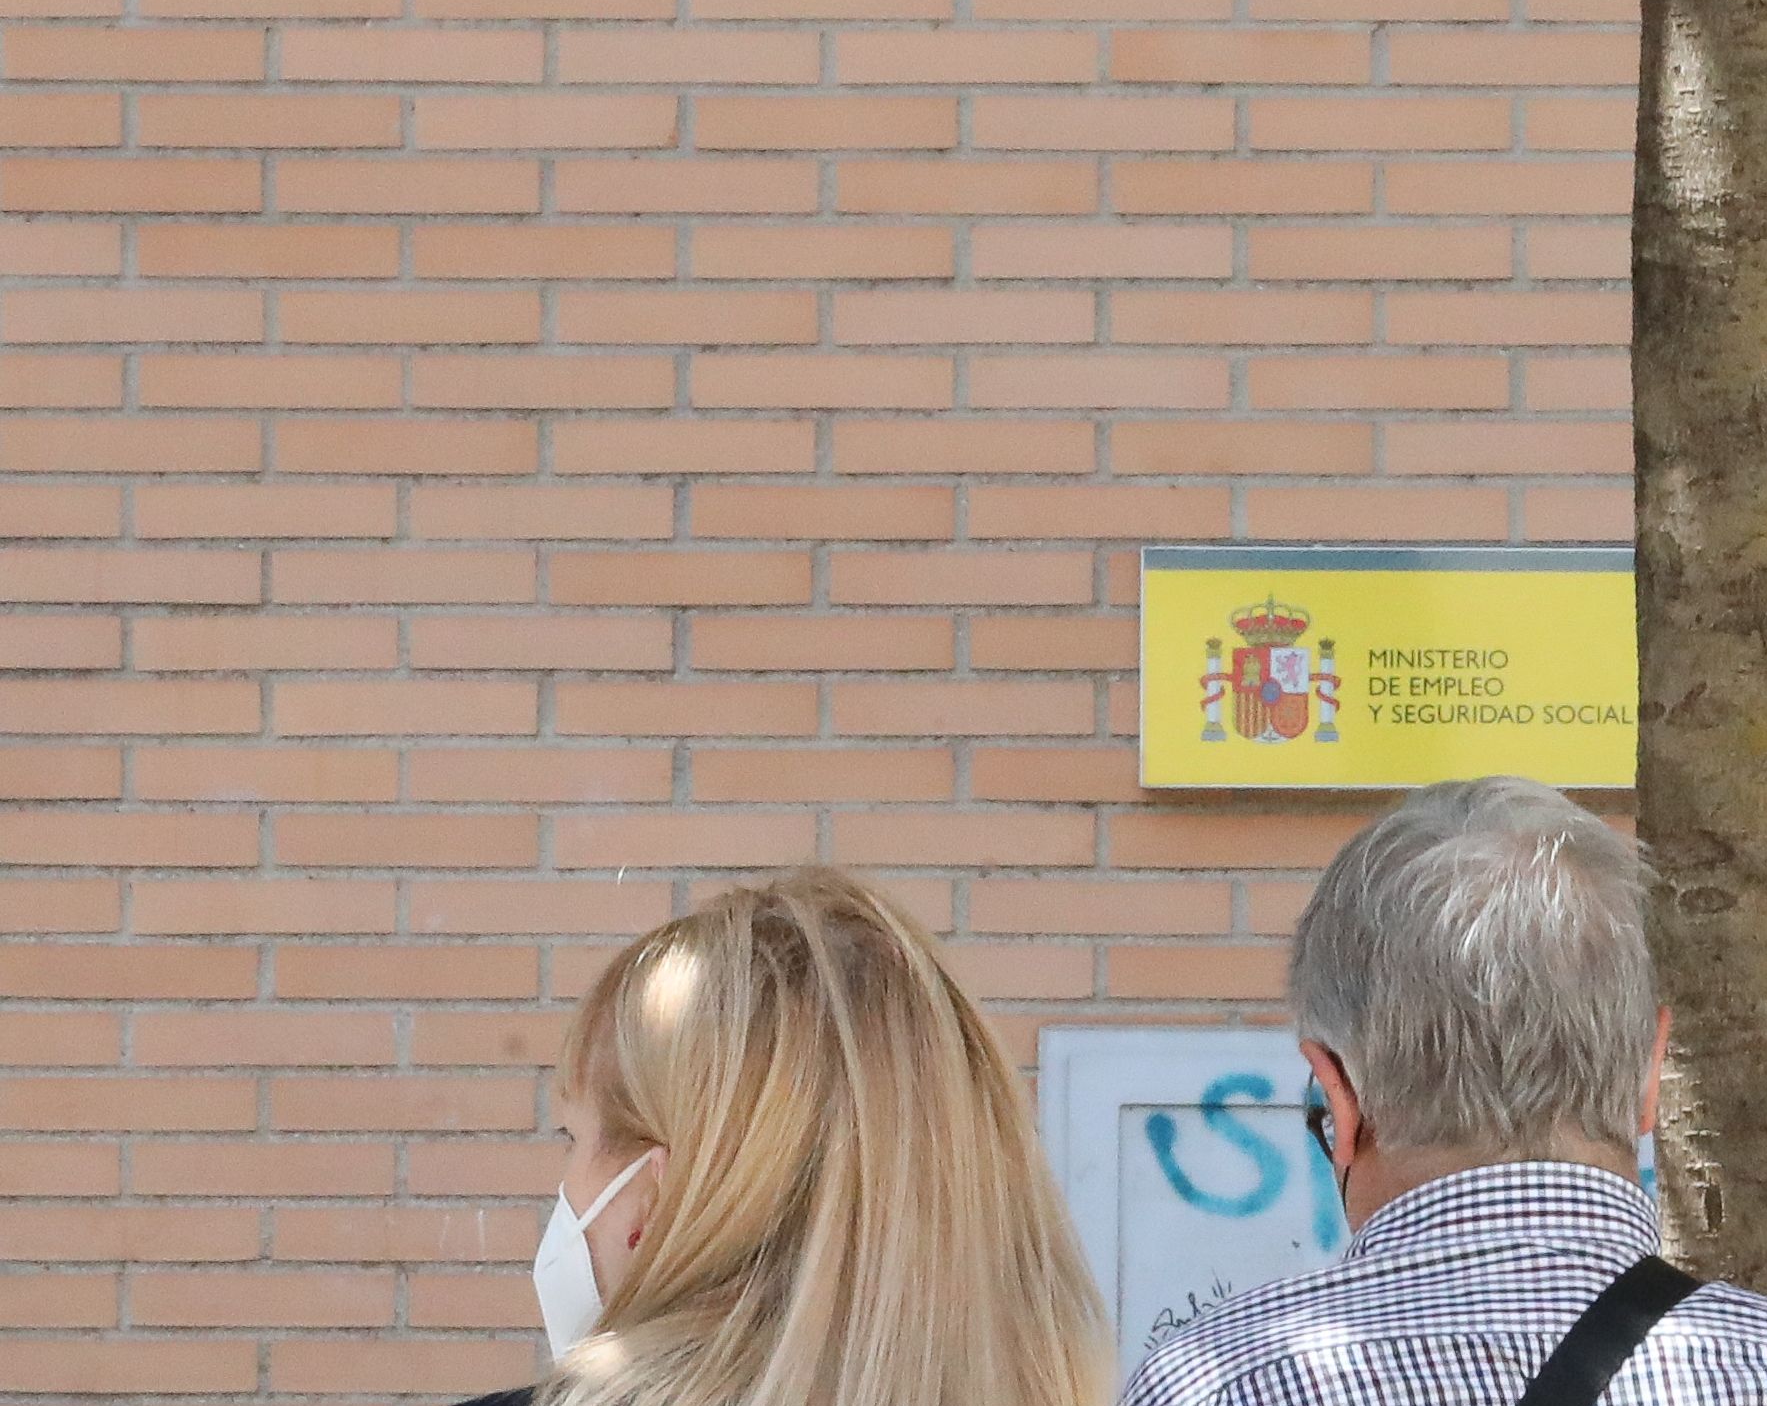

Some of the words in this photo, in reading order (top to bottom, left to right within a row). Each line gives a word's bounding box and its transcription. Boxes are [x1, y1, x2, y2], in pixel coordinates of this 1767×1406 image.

[1368, 648, 1510, 670] MINISTERIO
[1368, 676, 1401, 697] DE
[1409, 676, 1505, 697] EMPLEO
[1367, 704, 1384, 725] Y
[1391, 704, 1535, 725] SEGURIDAD
[1543, 704, 1635, 726] SOCIAL
